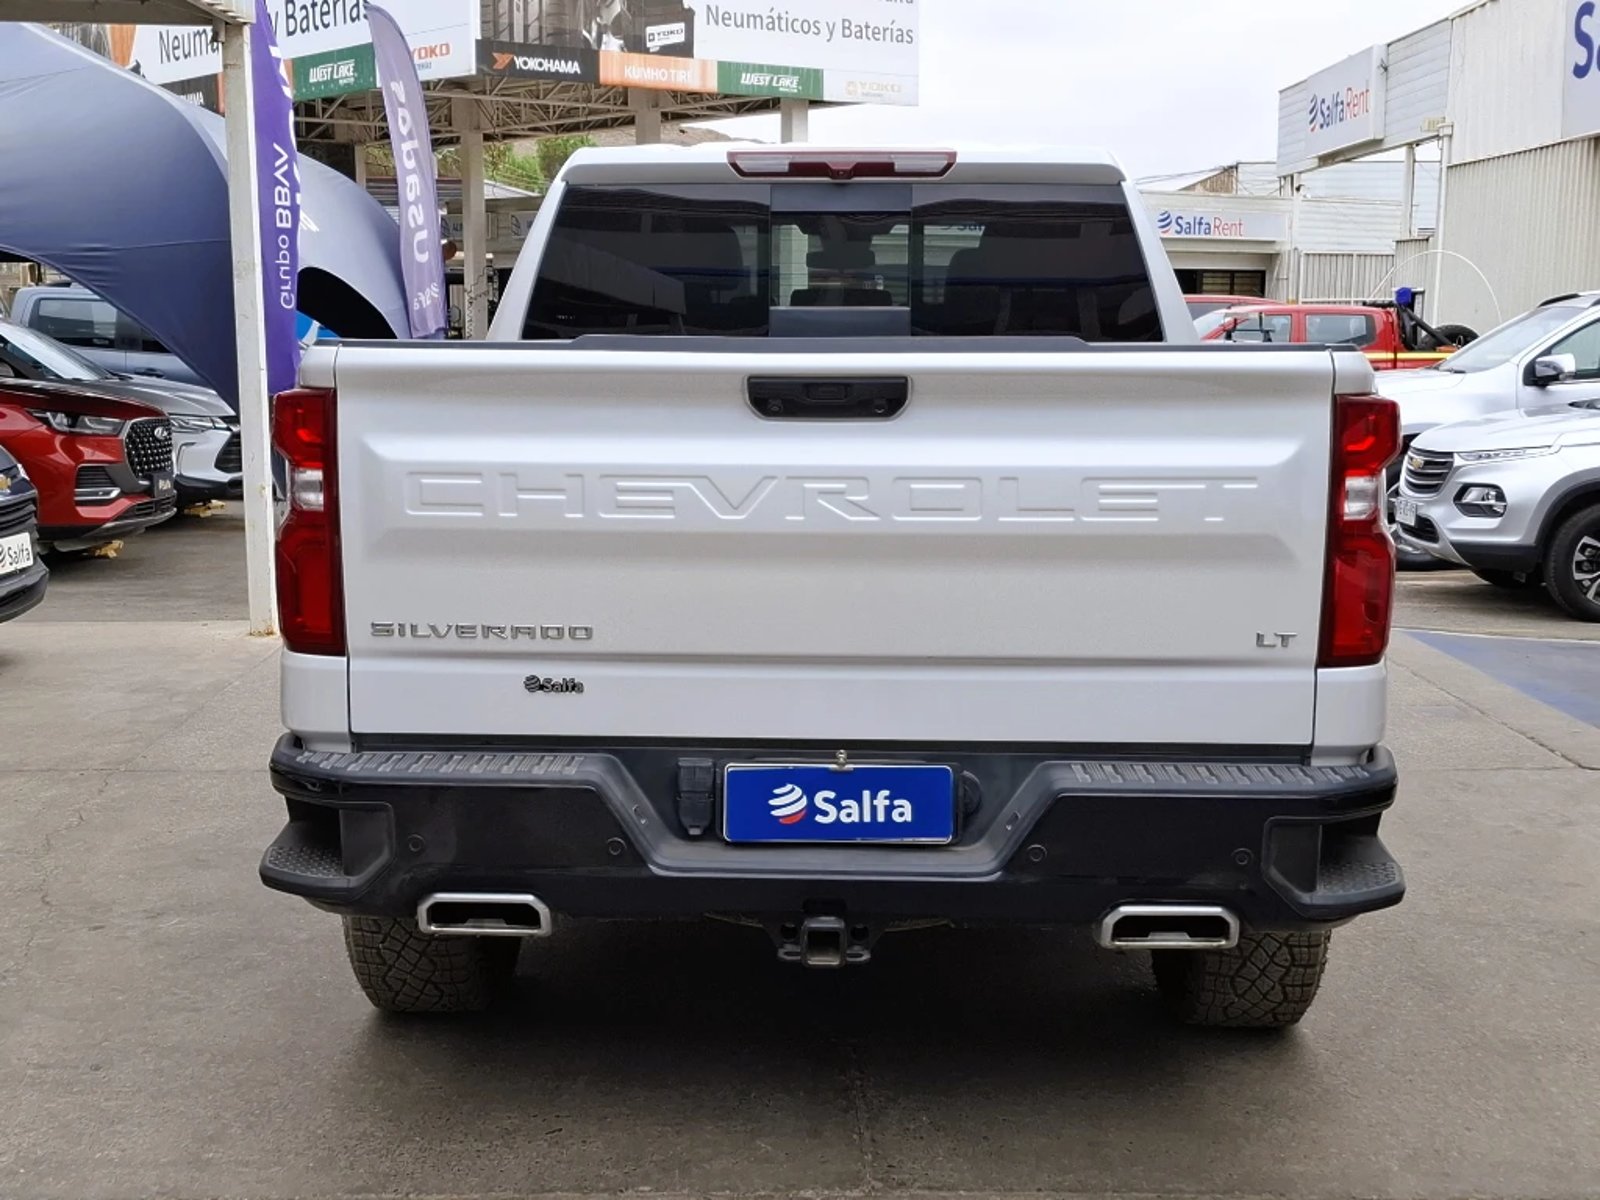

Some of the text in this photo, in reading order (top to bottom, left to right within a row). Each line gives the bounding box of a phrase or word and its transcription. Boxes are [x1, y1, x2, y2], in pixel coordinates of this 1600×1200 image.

[706, 4, 914, 44] Neumáticos y Baterías
[1573, 1, 1600, 78] S
[513, 56, 581, 75] YOKOHAMA
[625, 63, 668, 82] KUMHO
[405, 472, 1258, 520] CHEVROLET
[8, 543, 30, 566] Salfa
[371, 621, 594, 640] SILVERADO
[1256, 631, 1298, 647] LT
[541, 677, 584, 694] Salfa
[814, 790, 912, 824] Salfa
